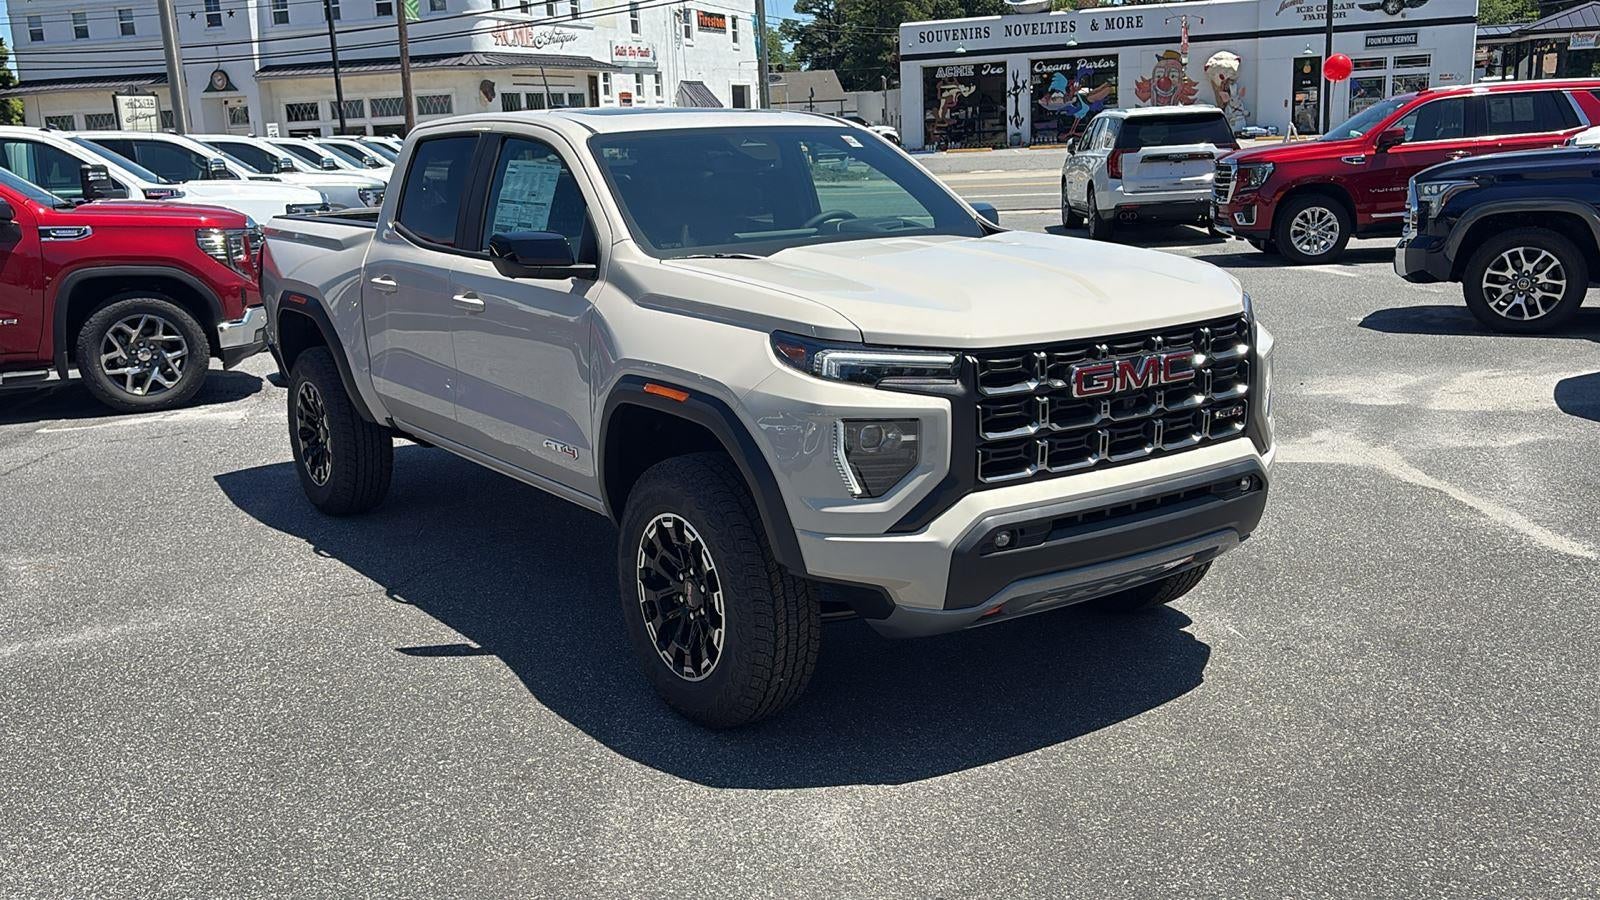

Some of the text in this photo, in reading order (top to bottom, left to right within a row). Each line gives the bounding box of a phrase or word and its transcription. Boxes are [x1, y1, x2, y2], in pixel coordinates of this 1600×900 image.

[1303, 11, 1347, 20] PAROR
[919, 15, 1144, 43] SOUVENIRS NOVELTIES & MORE
[1367, 34, 1417, 45] FOUNTAIN SERVICE
[935, 63, 1005, 78] ACME Ice
[1034, 58, 1117, 73] Cream Parlor
[1071, 347, 1196, 398] GMC
[543, 439, 579, 461] AT4
